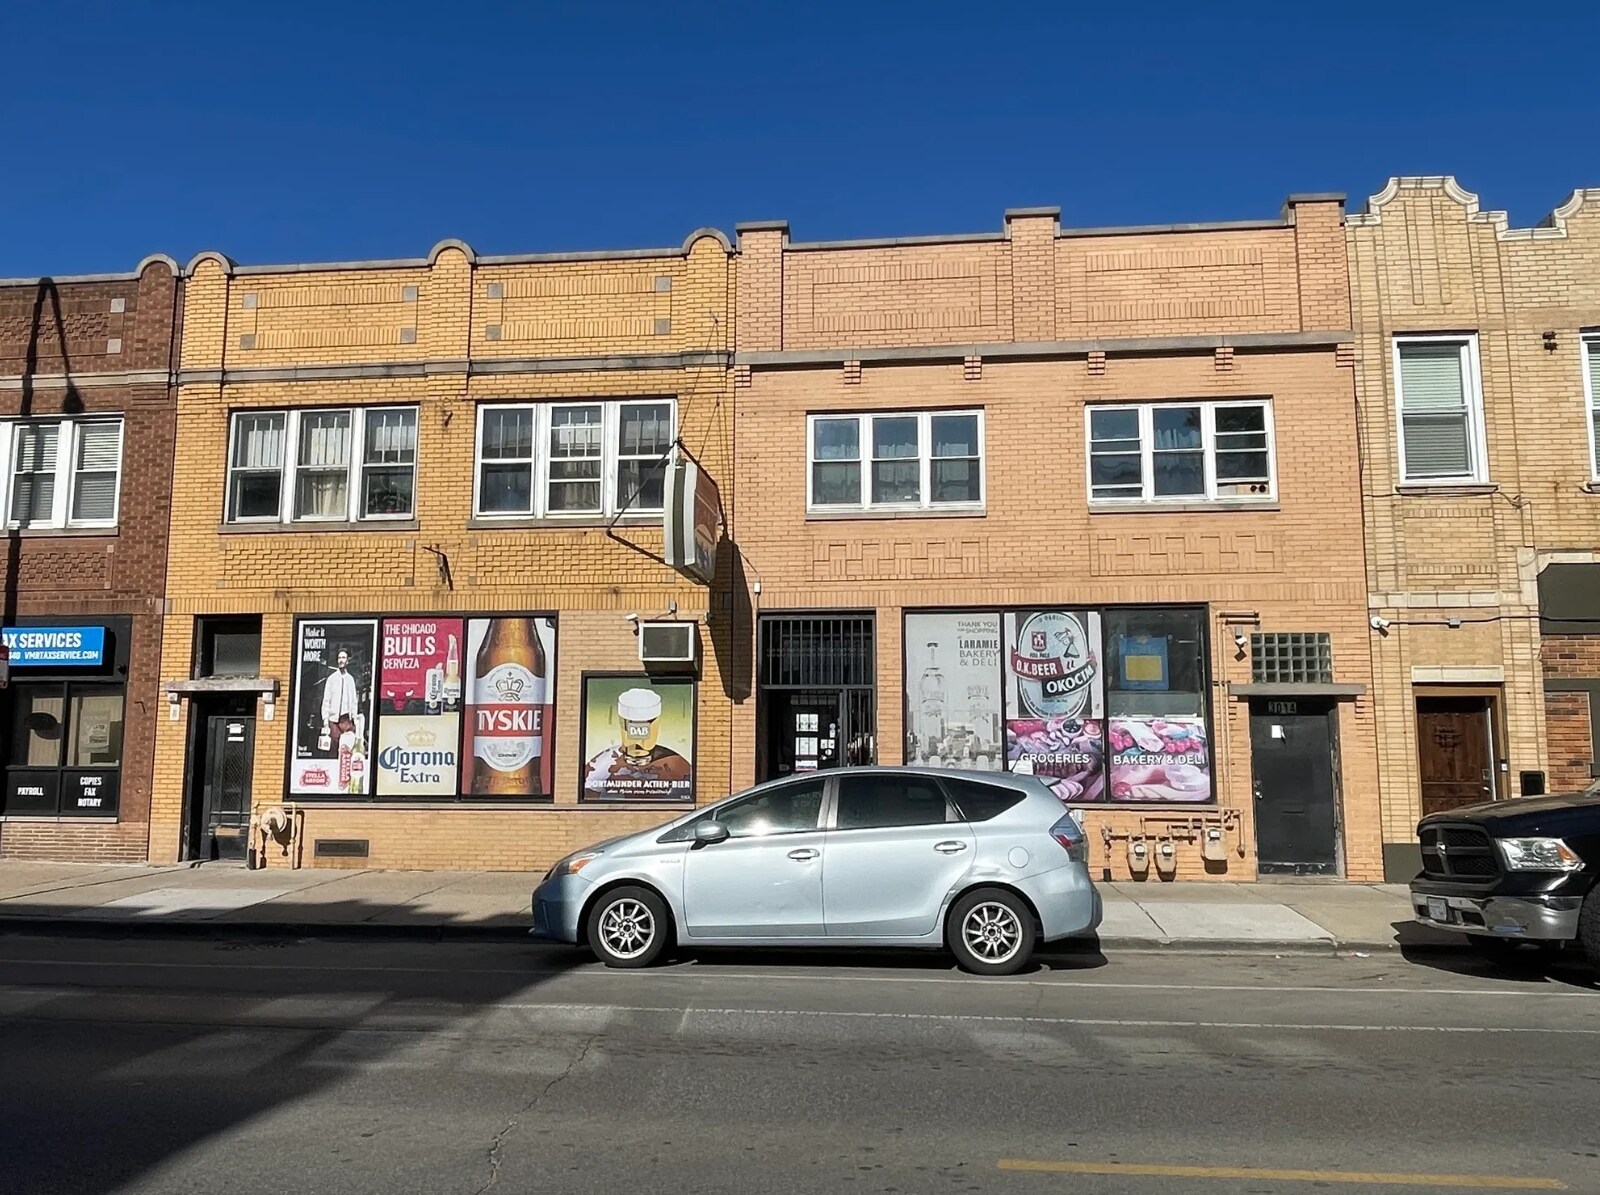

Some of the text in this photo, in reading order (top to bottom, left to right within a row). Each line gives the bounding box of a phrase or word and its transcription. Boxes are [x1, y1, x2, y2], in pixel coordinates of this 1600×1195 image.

[385, 623, 436, 634] THE CHICAGO
[19, 633, 82, 648] SERVICES
[304, 639, 326, 649] WORTH
[959, 639, 998, 649] LARAMIE
[384, 636, 436, 656] BULLS
[303, 651, 322, 662] MORE
[959, 650, 998, 658] BAKERY
[383, 658, 420, 669] CERVEZA
[972, 658, 997, 666] DELI
[1046, 664, 1094, 694] OKOCIM
[477, 710, 541, 731] TYSKIE
[630, 726, 648, 735] DAB
[379, 746, 455, 773] Corona
[1020, 753, 1090, 764] GROCERIES
[1113, 755, 1205, 765] BAKERY & DELI
[400, 768, 440, 783] Extra
[80, 777, 102, 785] COPIES
[17, 787, 44, 796] PAYROLL
[84, 787, 97, 796] FAX
[77, 798, 102, 807] NOTARY
